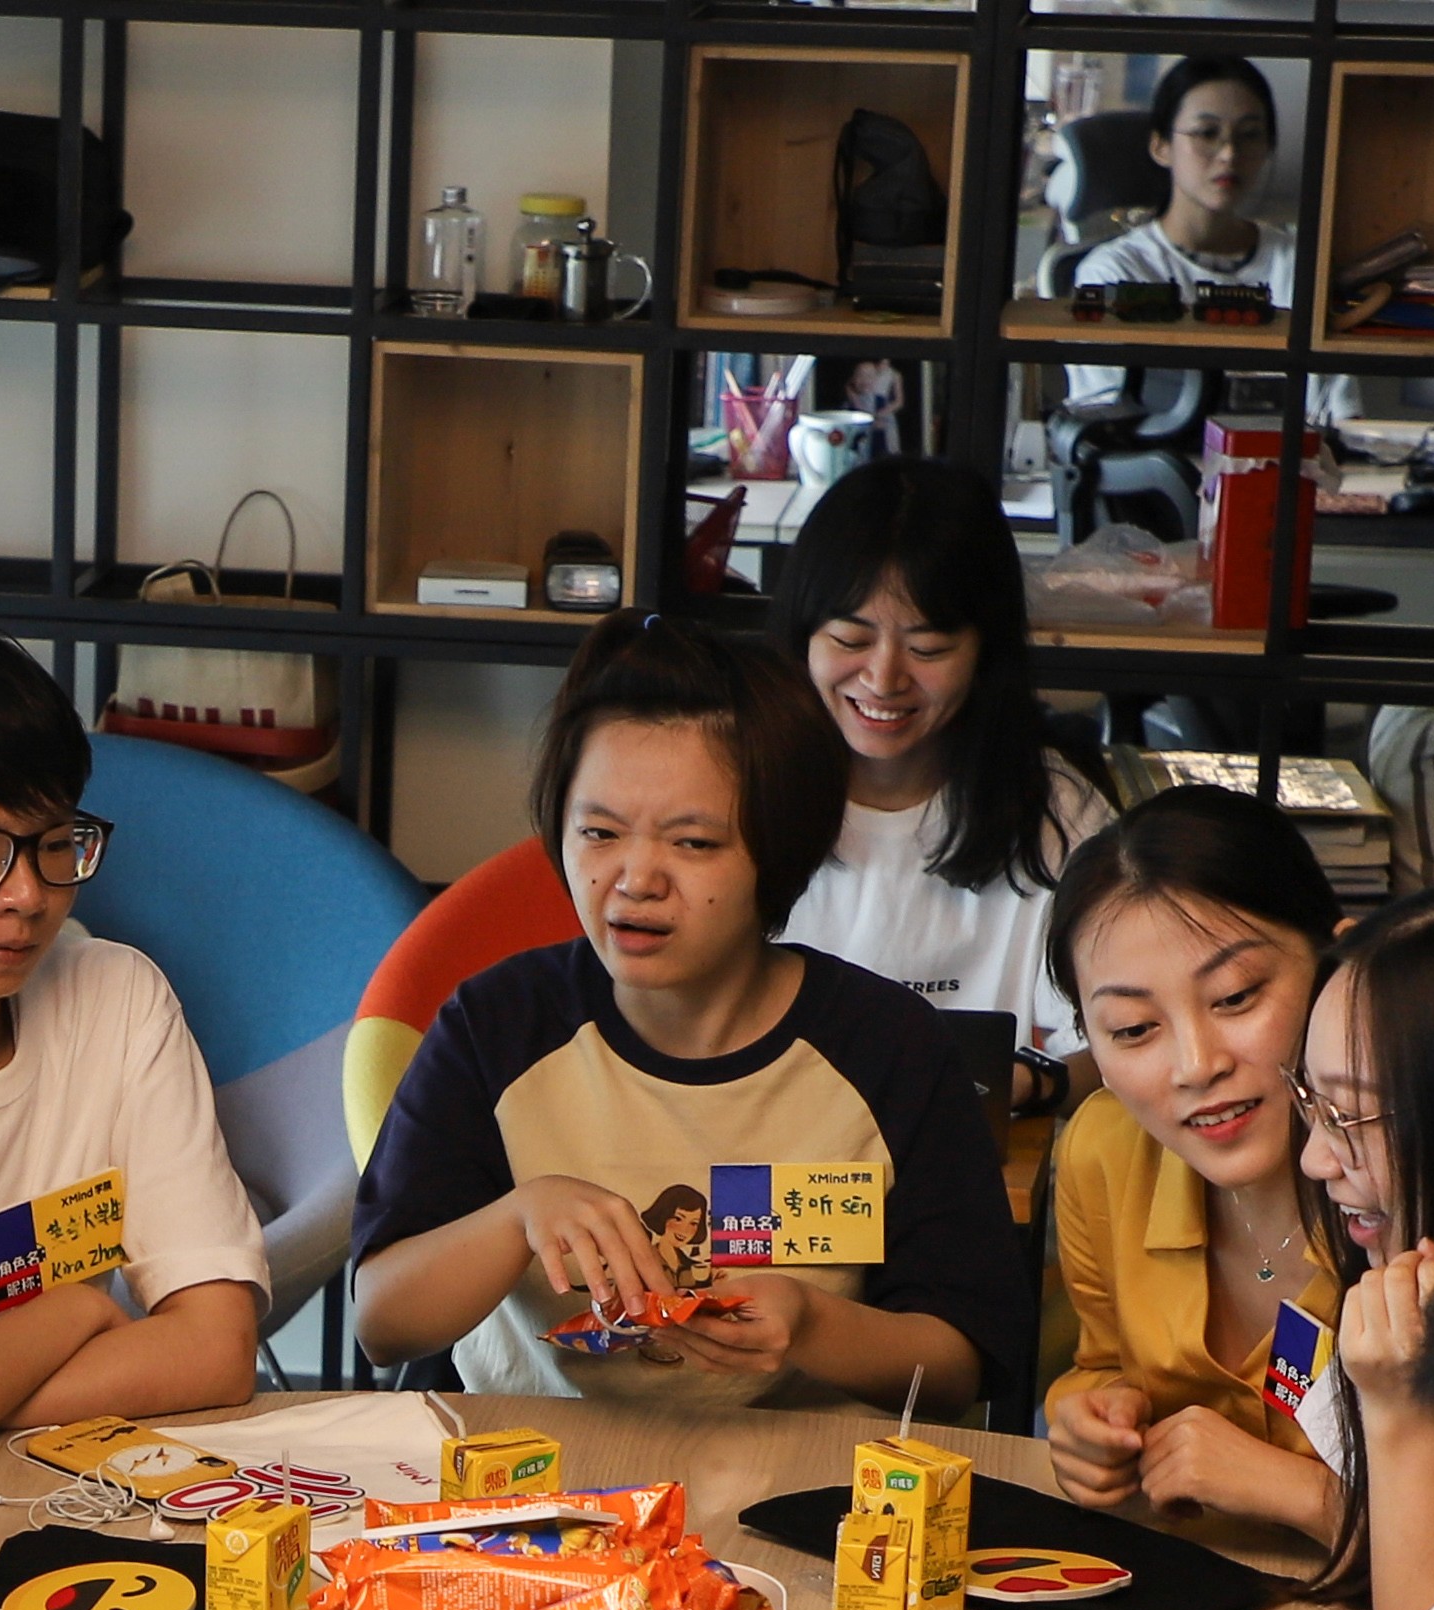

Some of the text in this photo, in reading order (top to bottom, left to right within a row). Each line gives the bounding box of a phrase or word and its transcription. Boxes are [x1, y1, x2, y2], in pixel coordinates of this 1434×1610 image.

[808, 1172, 873, 1184] XMind 学院
[61, 1187, 94, 1208] XMind
[51, 1262, 86, 1283] Kira
